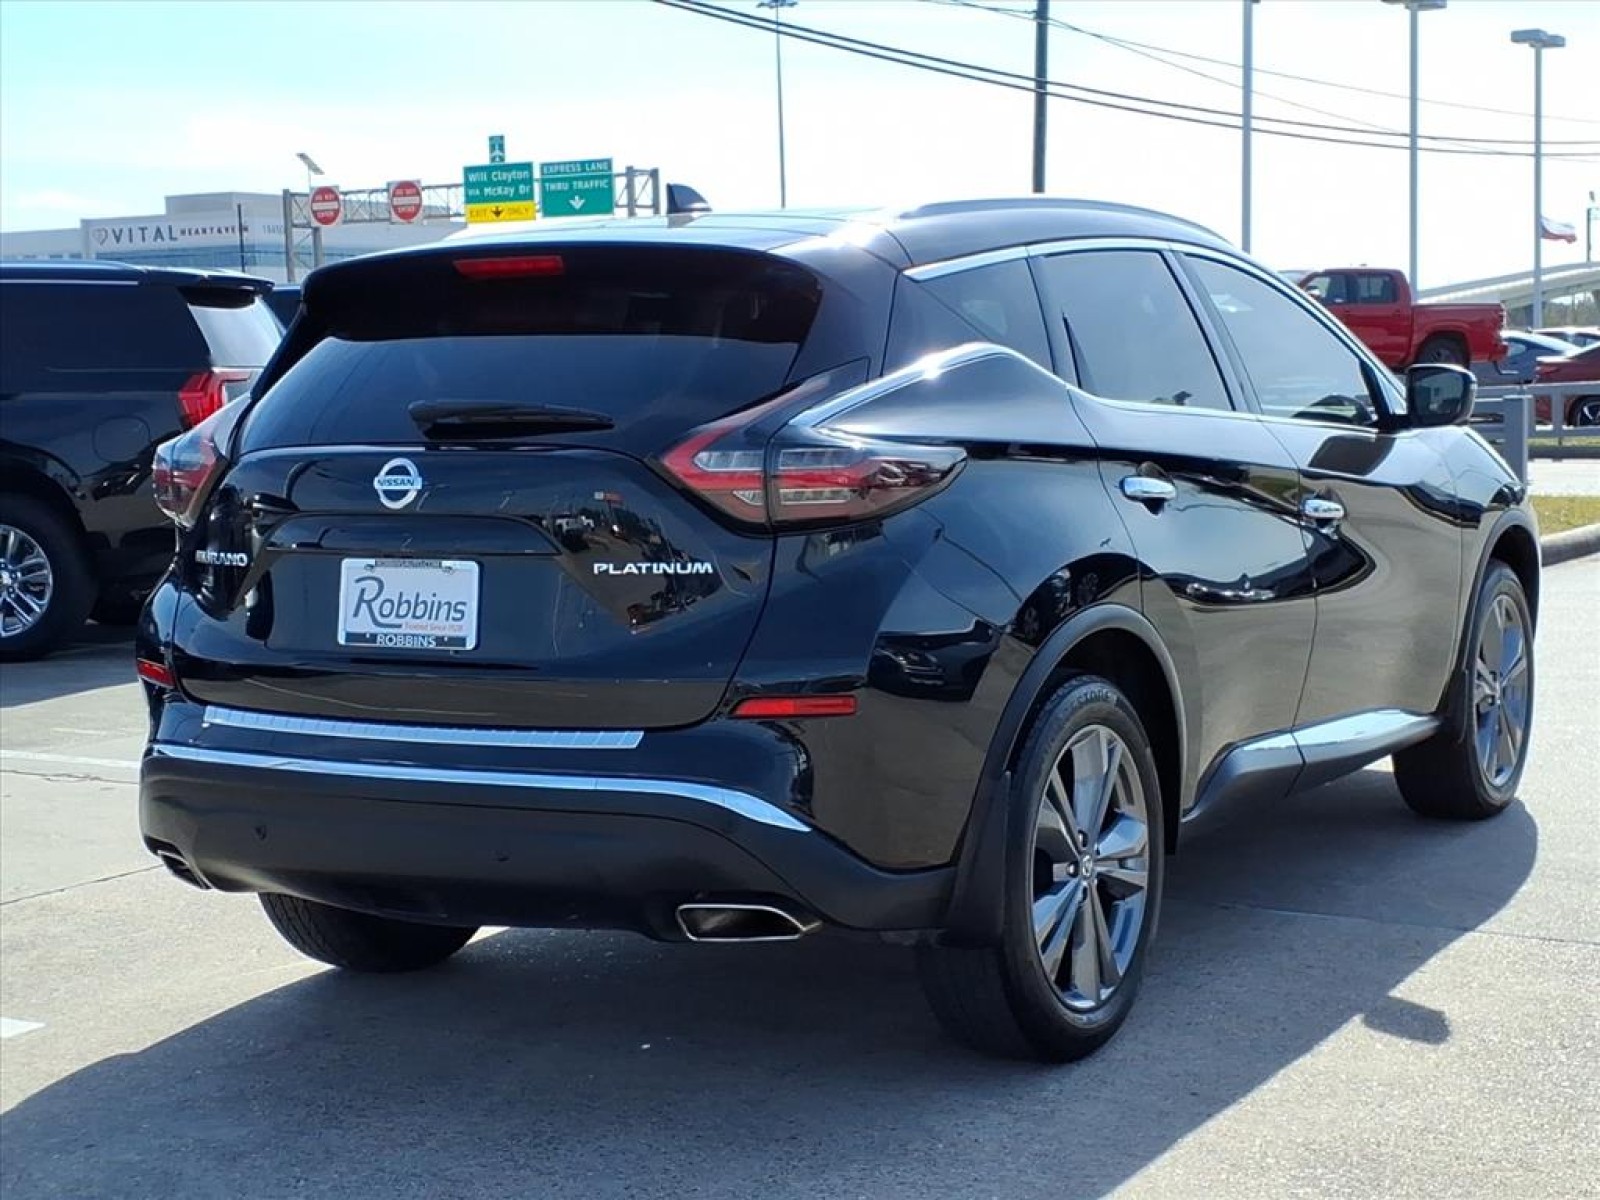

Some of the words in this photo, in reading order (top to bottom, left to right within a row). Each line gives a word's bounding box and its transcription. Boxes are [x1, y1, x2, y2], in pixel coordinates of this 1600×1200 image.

[543, 164, 581, 174] EXPRESS
[586, 161, 609, 171] LANE
[468, 171, 488, 182] Will
[491, 170, 530, 182] Clayton
[484, 185, 514, 198] McKay
[519, 184, 531, 195] Dr
[544, 182, 569, 192] THRU
[573, 179, 609, 190] TRAFFIC
[469, 208, 488, 219] EXIT
[112, 224, 178, 244] VITAL
[377, 478, 415, 487] NISSAN
[593, 561, 714, 576] PLATINUM
[352, 575, 468, 629] Robbins
[376, 633, 437, 648] ROBBINS
